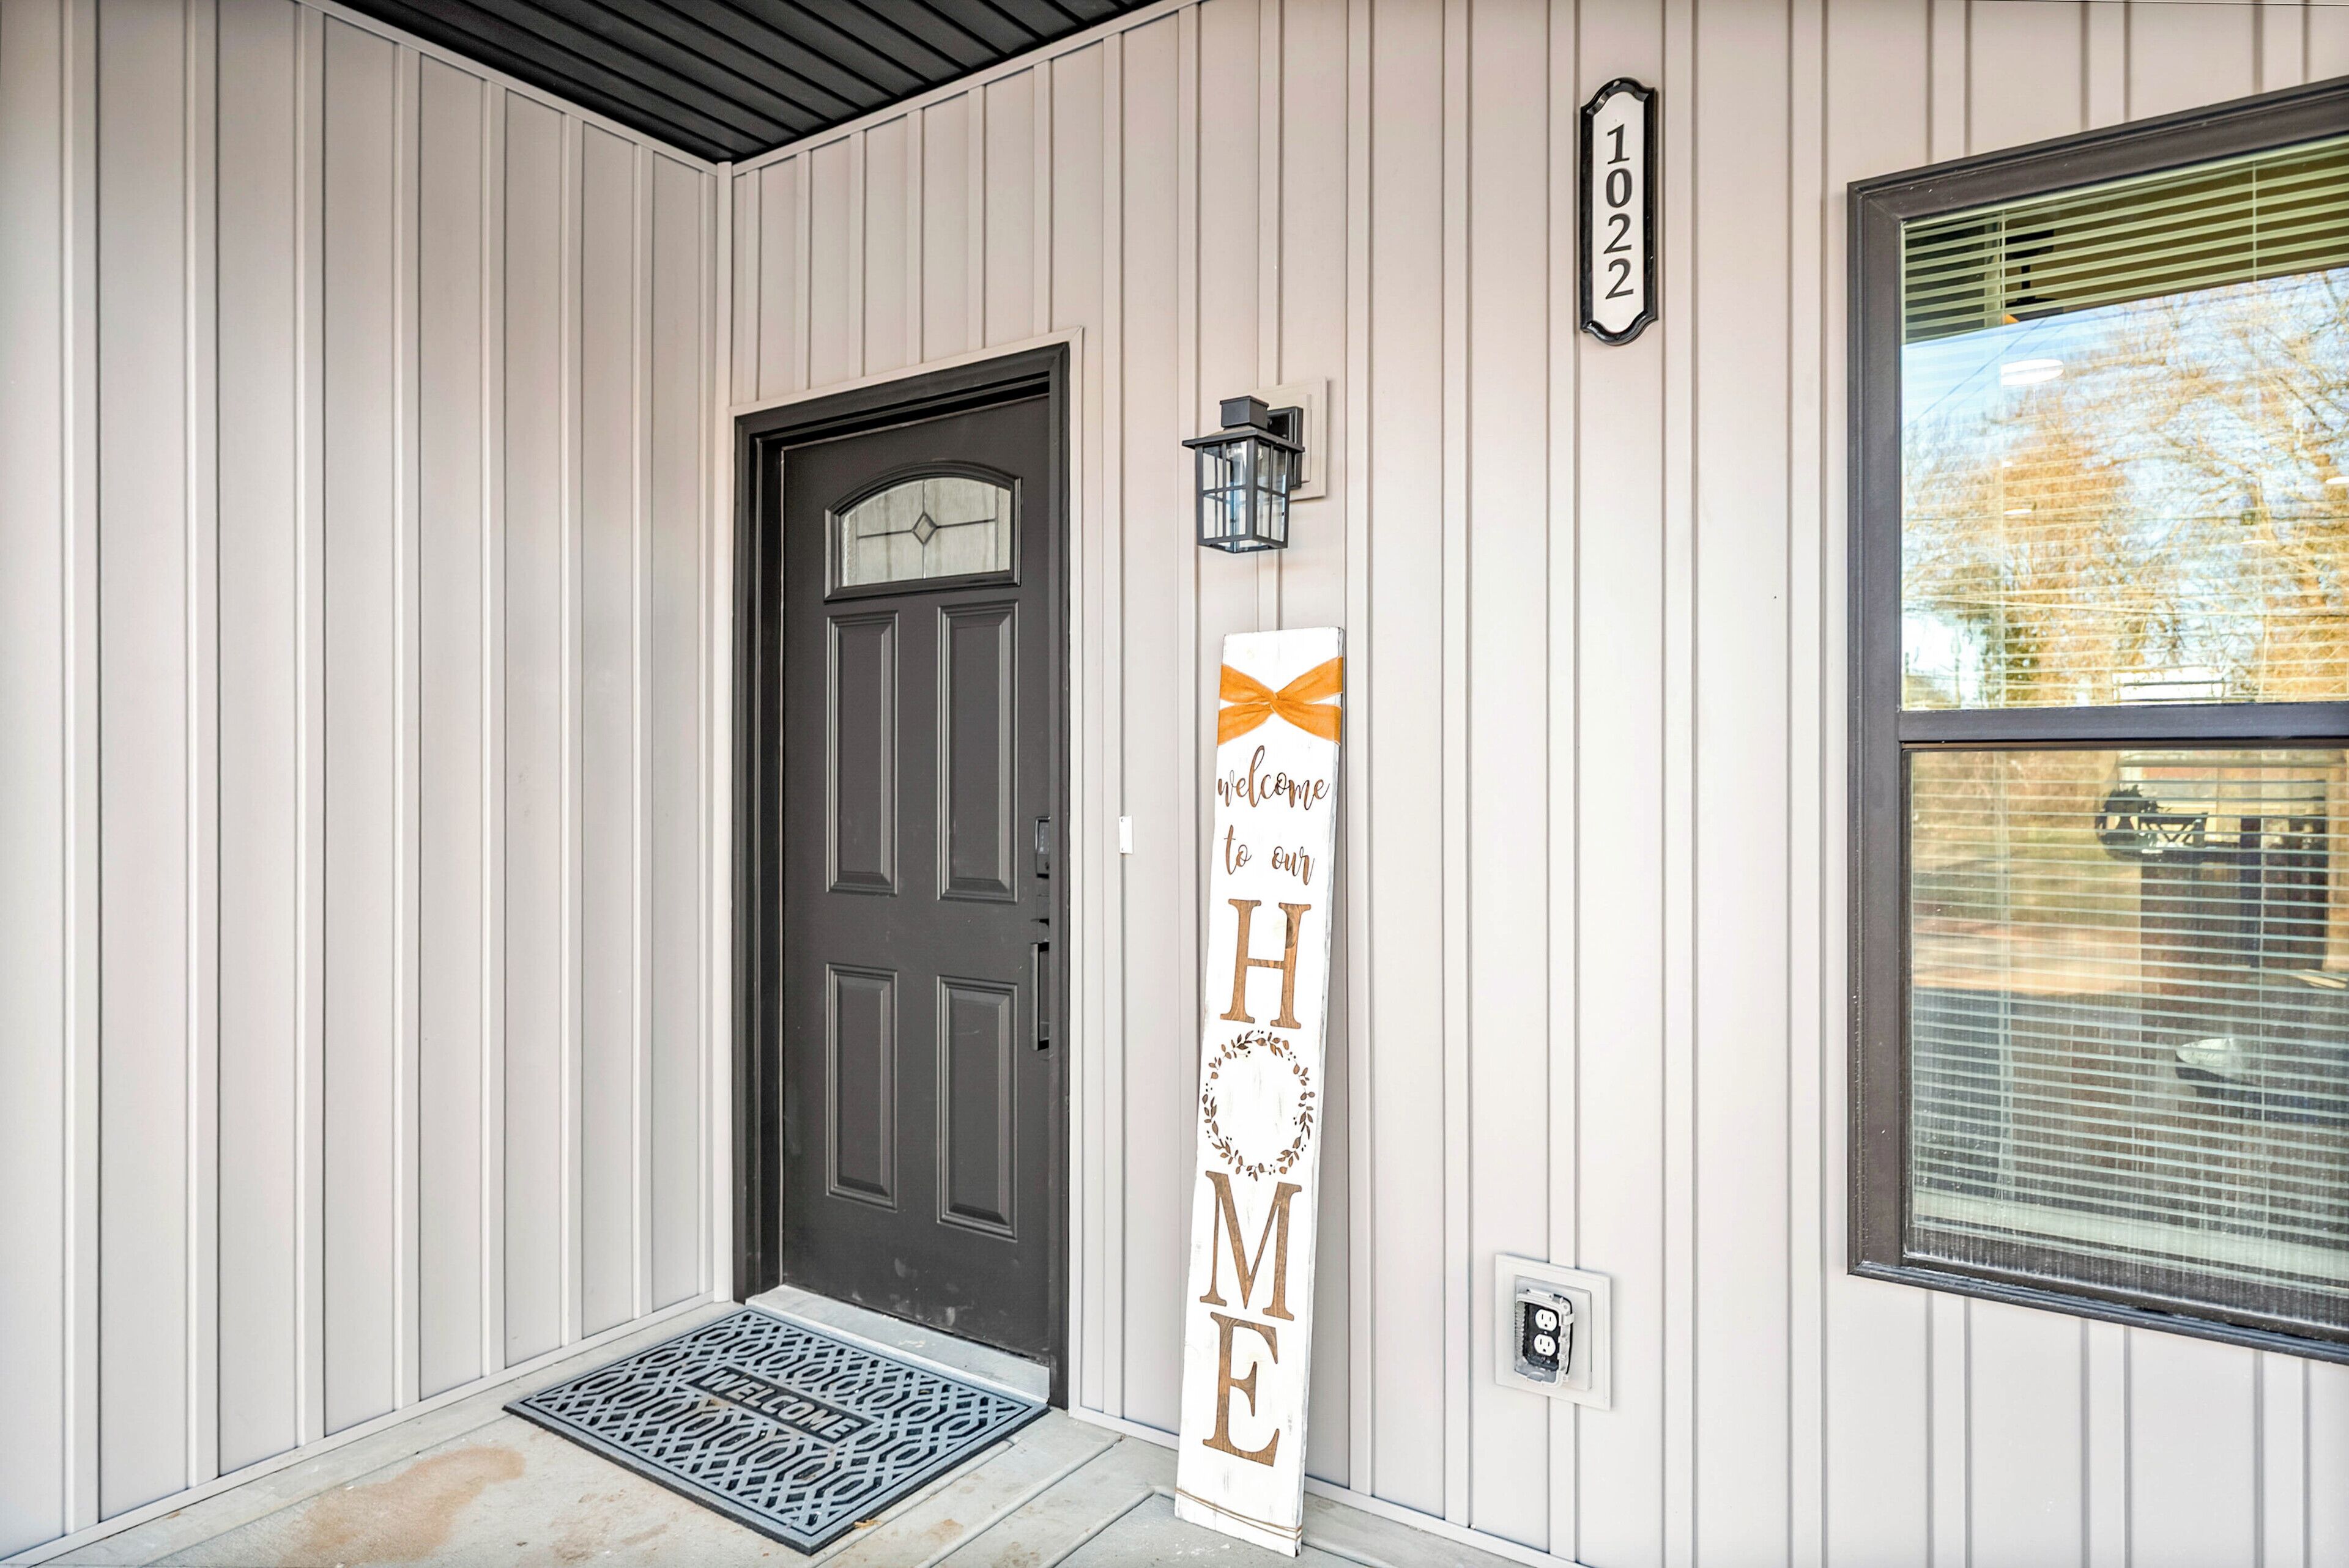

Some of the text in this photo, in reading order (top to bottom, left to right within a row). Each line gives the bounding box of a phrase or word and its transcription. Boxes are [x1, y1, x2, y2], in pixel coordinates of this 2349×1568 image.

[1603, 124, 1634, 300] 1022
[1217, 745, 1330, 810] welcome
[1223, 824, 1315, 886] to our
[699, 1369, 862, 1438] WELCOME
